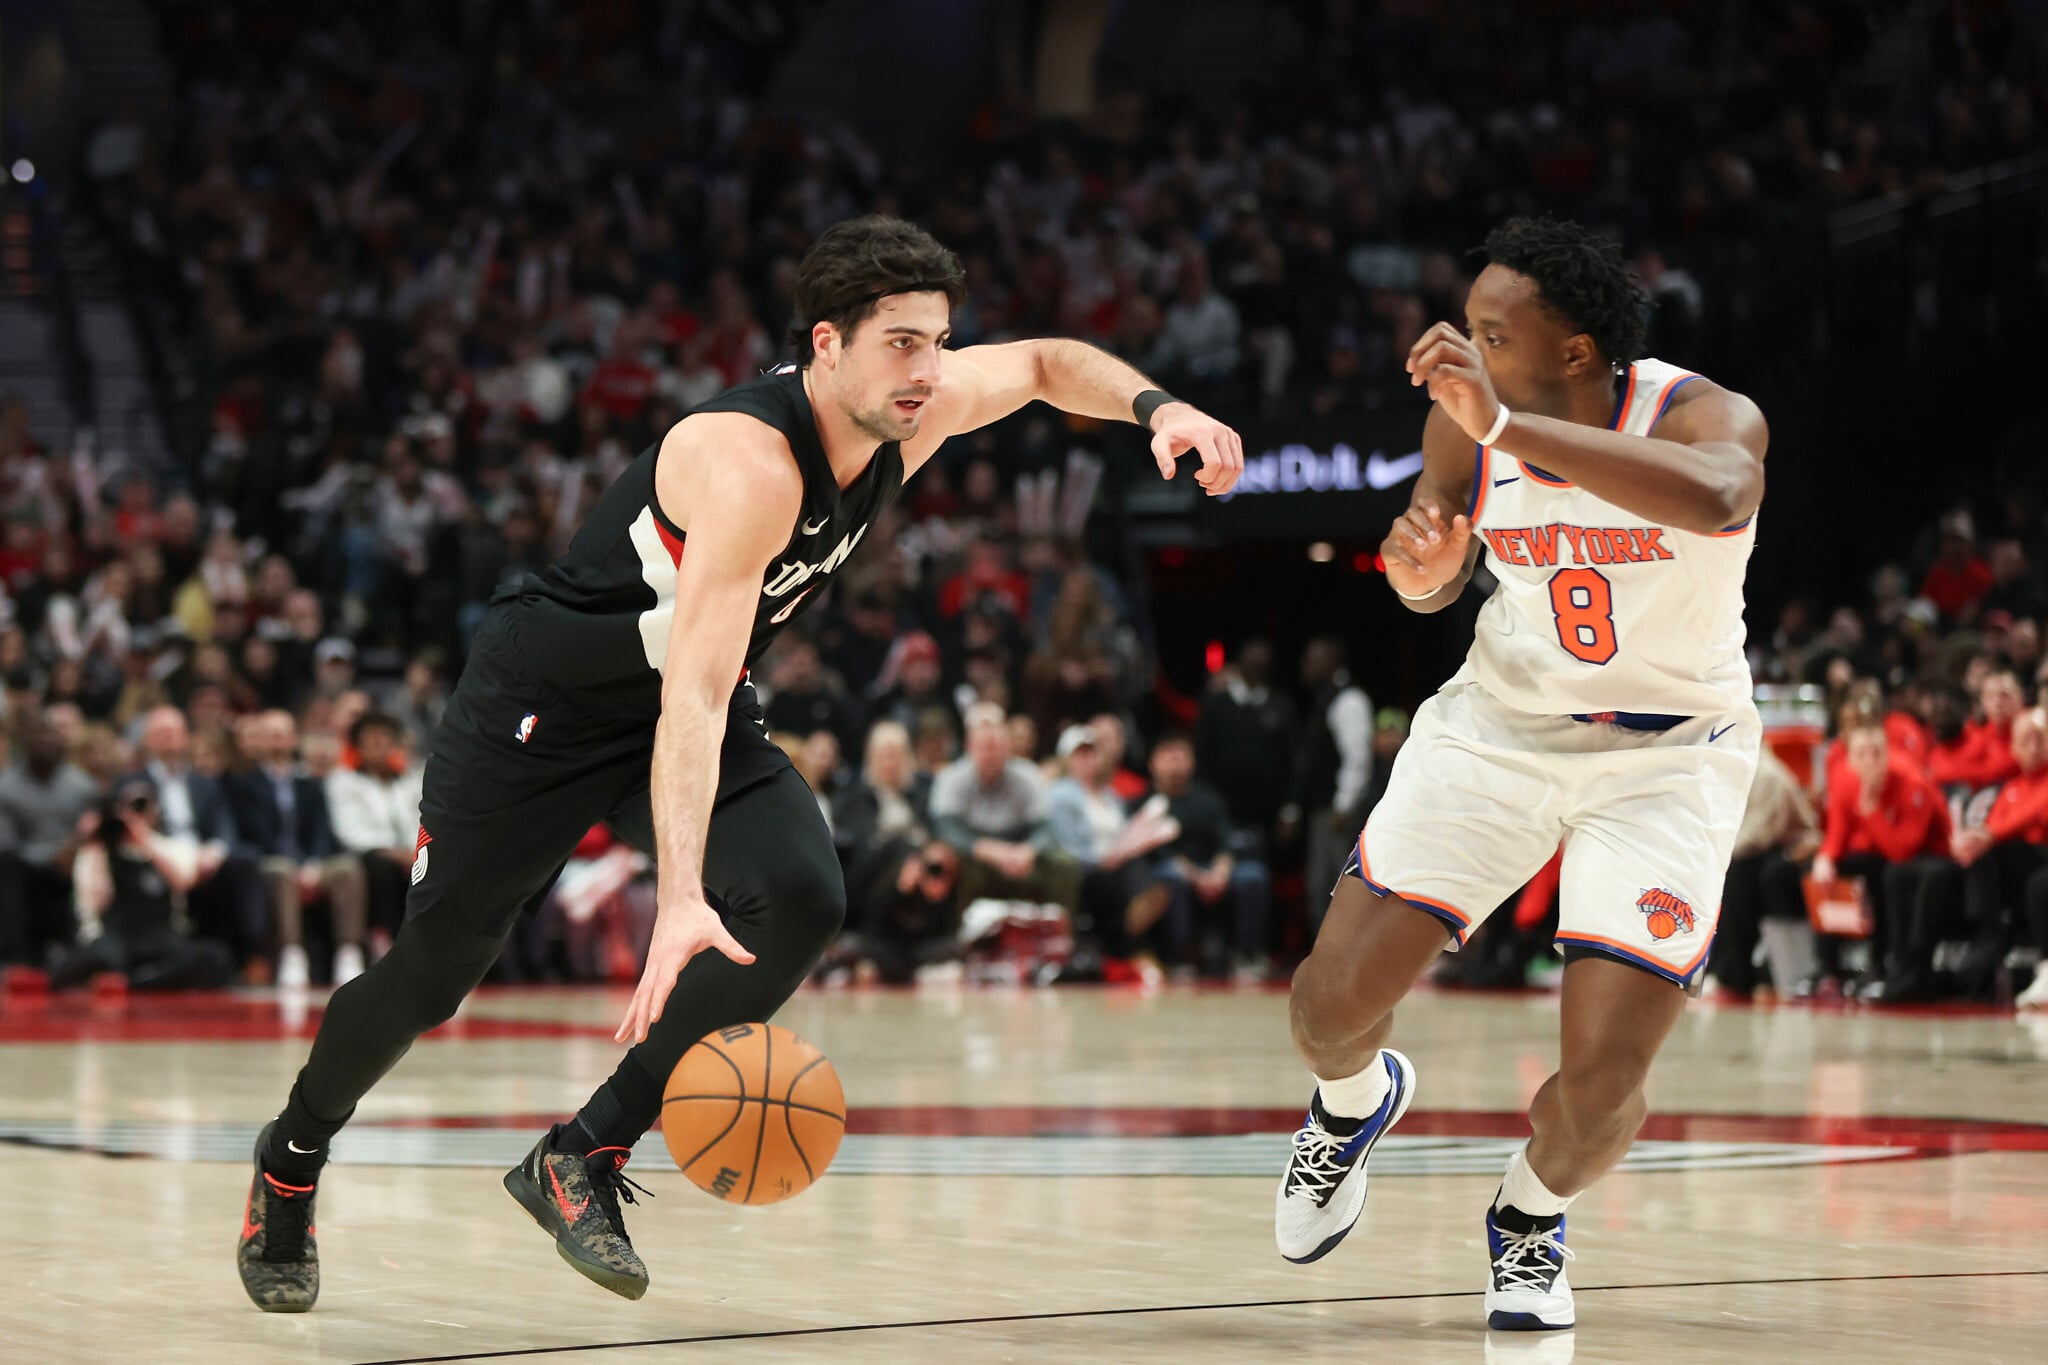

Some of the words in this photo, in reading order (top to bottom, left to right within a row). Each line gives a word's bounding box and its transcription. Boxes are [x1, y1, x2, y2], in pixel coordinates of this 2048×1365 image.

[1482, 521, 1560, 567] NEW
[1560, 522, 1675, 565] YORK
[1547, 566, 1619, 666] 8
[1635, 887, 1694, 932] KNICKS
